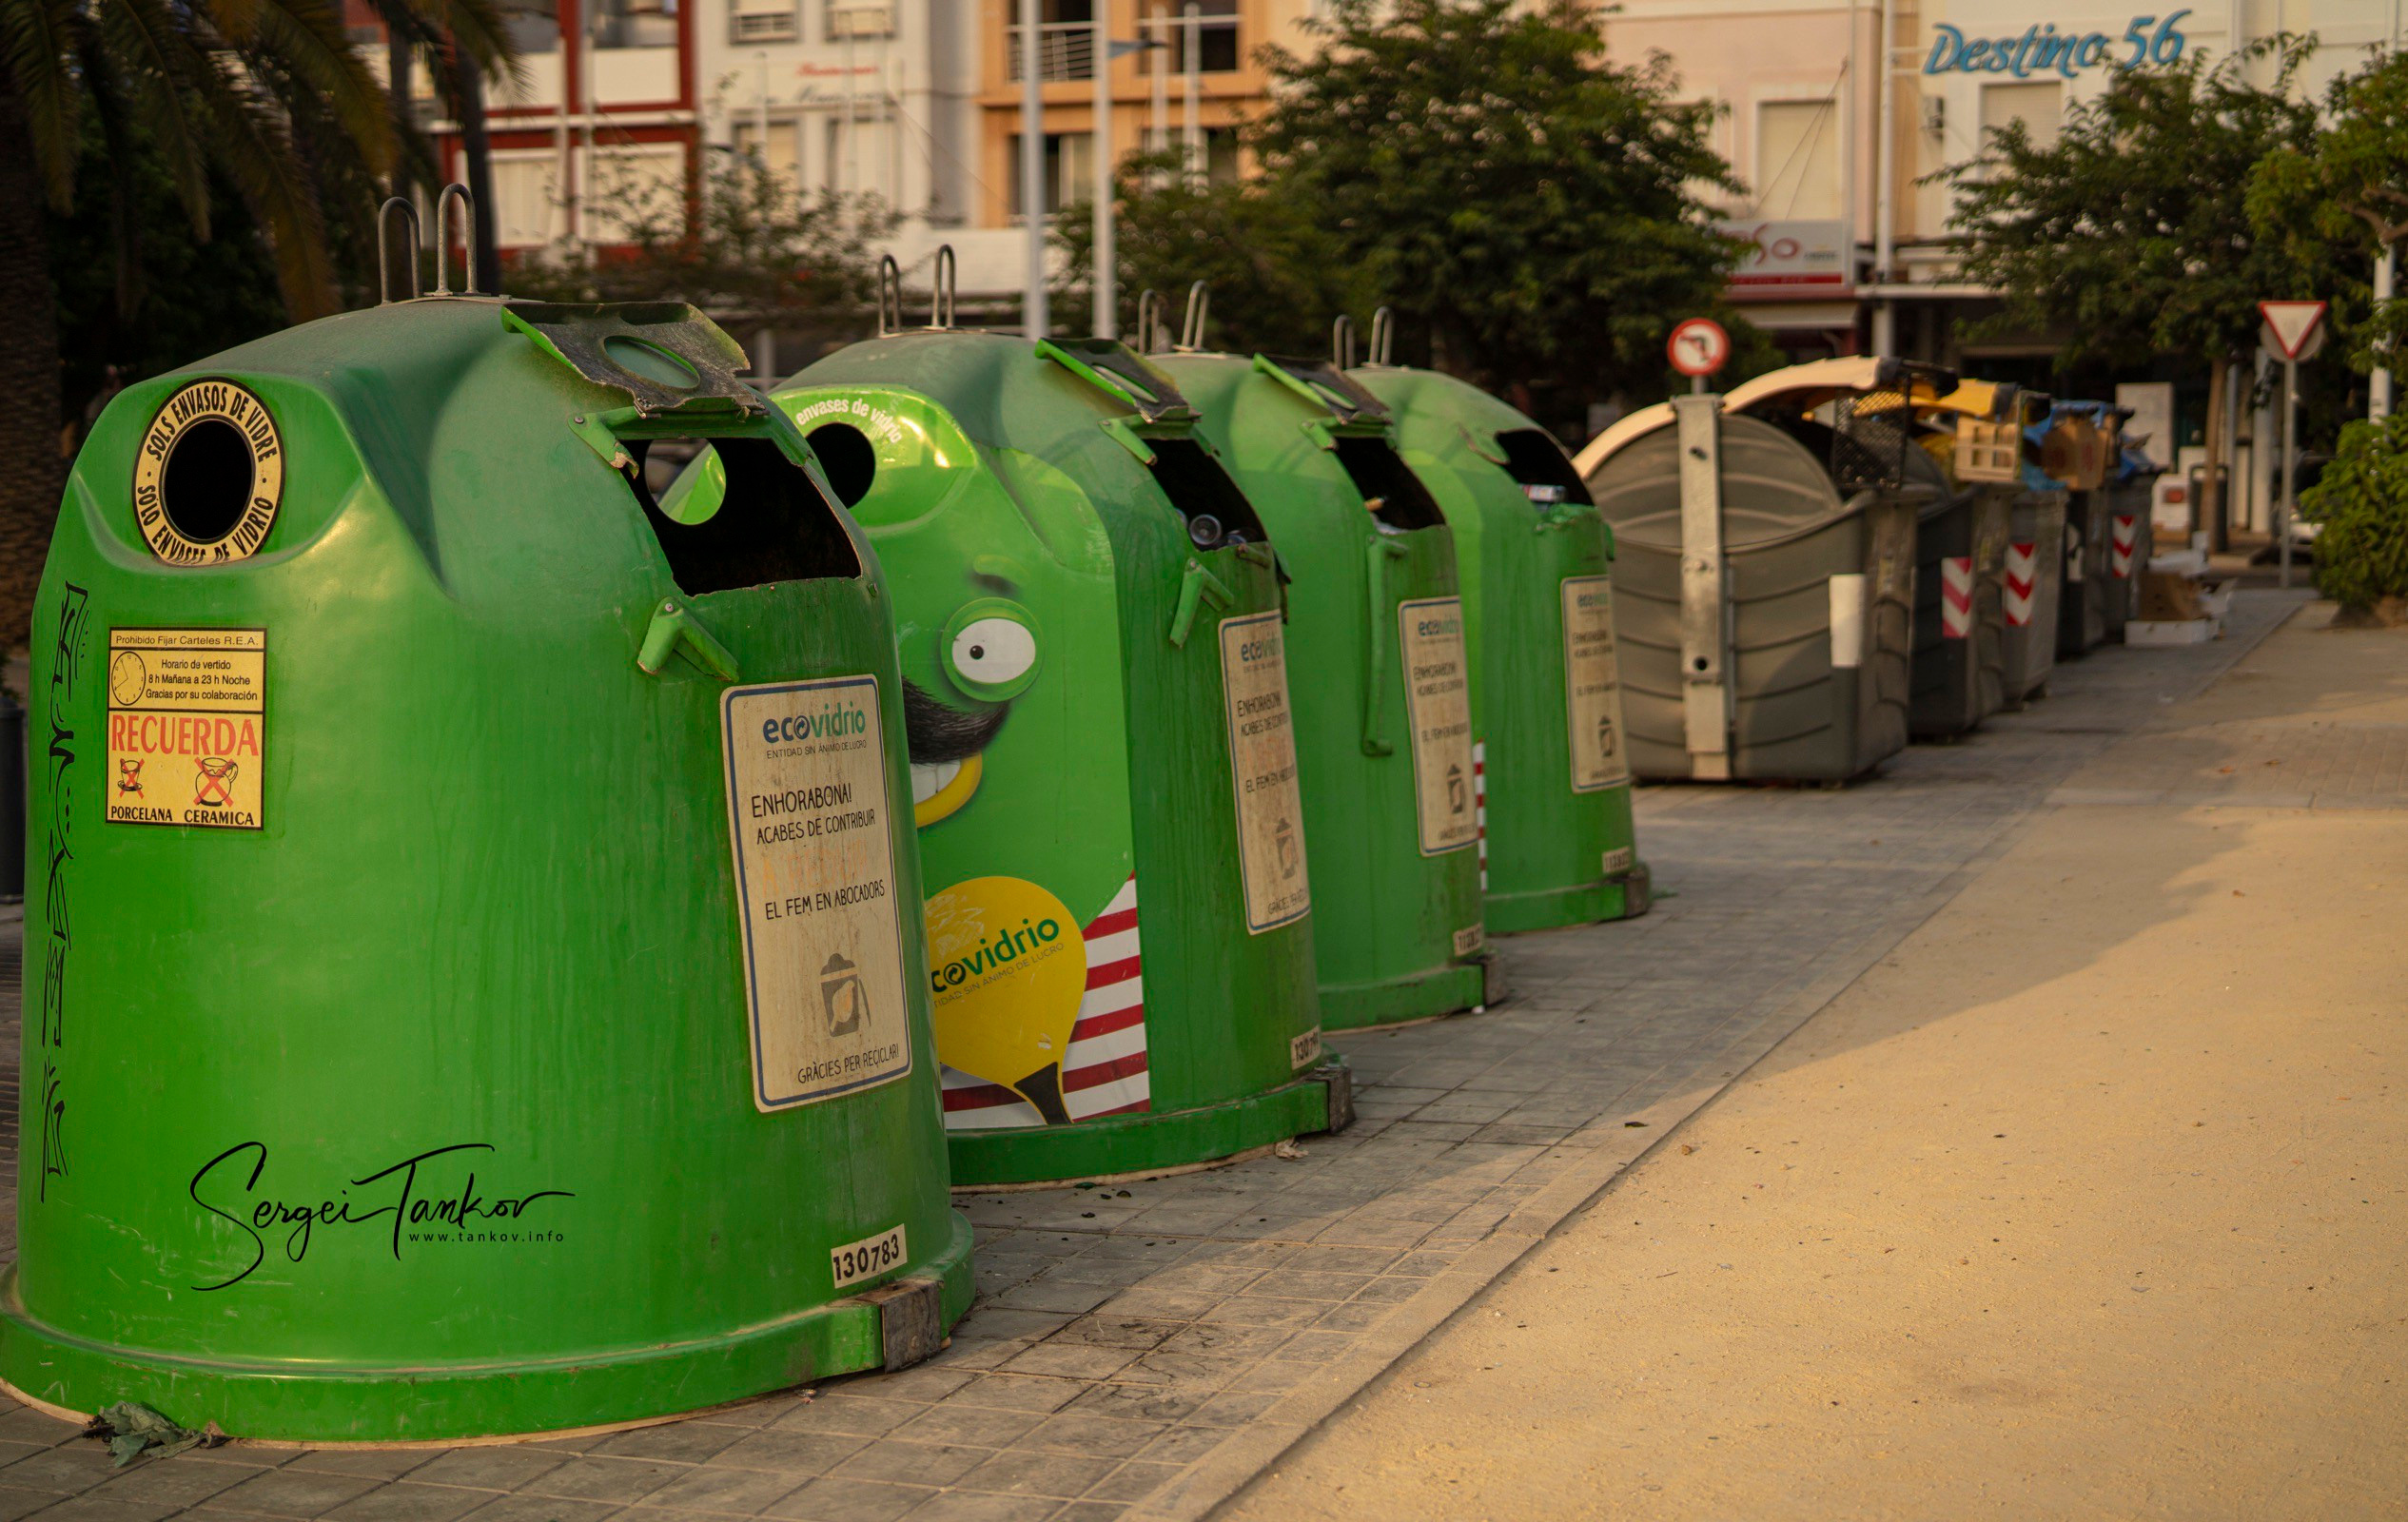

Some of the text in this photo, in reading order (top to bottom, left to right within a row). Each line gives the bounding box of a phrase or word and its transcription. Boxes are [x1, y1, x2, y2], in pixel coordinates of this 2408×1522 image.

[1922, 9, 2193, 79] Destino 56
[147, 384, 278, 463] SOLS ENVASOS DE VIDRE
[795, 398, 903, 444] envases de vidrio
[151, 524, 206, 565] ENVASES
[211, 542, 230, 564] DE
[231, 497, 274, 556] VIDRIO
[115, 634, 259, 647] Prohibido Fijar Carteles R.E.A.
[148, 674, 154, 684] 8
[154, 674, 160, 684] h
[161, 673, 191, 685] Mañana
[201, 674, 212, 685] 23
[214, 674, 220, 684] h
[222, 674, 251, 686] Noche
[161, 658, 231, 671] Horario de vertido
[146, 689, 258, 701] Gracias por su colaboración
[111, 714, 260, 756] RECUERDA
[762, 700, 867, 744] ecovidrio
[767, 748, 803, 759] ENTIDAD
[804, 746, 816, 755] SIN
[841, 742, 851, 751] DE
[850, 739, 867, 751] LUCRO
[110, 806, 255, 826] PORCELANA CERAMICA
[751, 783, 852, 818] ENHORABONA!
[756, 809, 876, 846] ACABES DE CONTRIBUIR
[765, 879, 886, 921] EL FEM EN ABOCADORS
[964, 981, 980, 996] SIN
[1015, 958, 1030, 971] DE
[1030, 942, 1066, 965] LUCRO
[797, 1043, 900, 1084] GRÀCIES PER RECICLAR!
[832, 1233, 900, 1281] 130783
